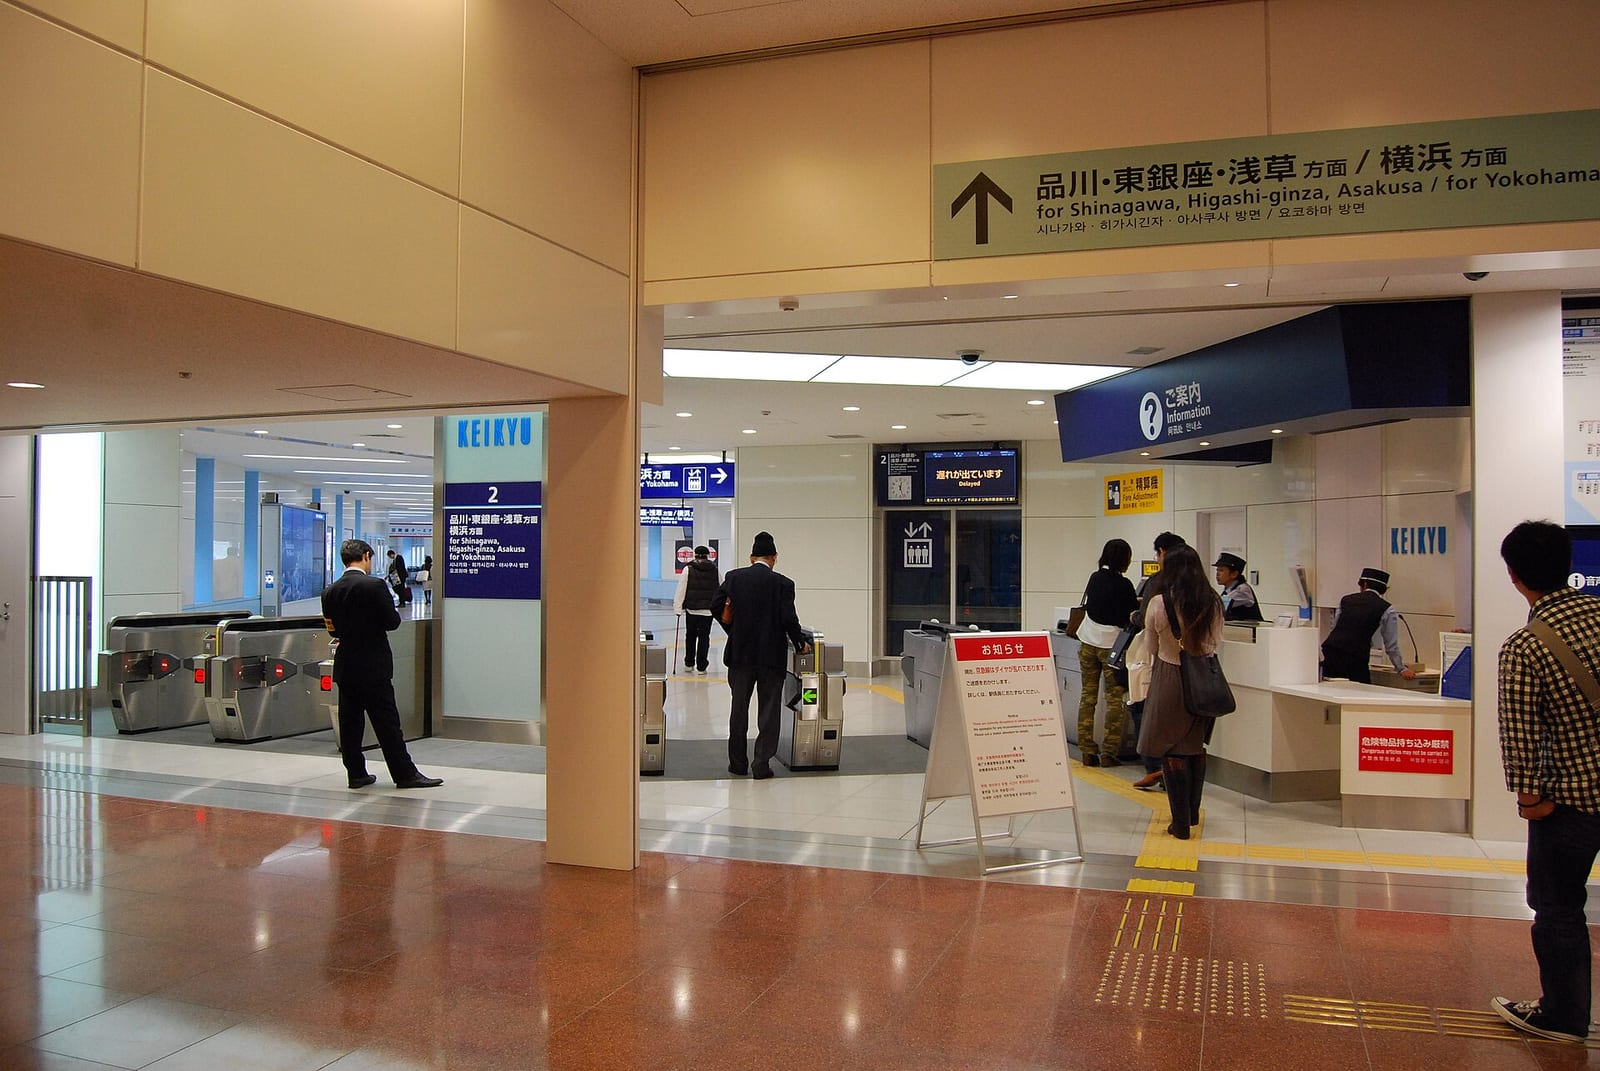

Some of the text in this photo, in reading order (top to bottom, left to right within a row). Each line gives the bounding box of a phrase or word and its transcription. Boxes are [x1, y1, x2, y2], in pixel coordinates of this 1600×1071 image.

[1037, 205, 1064, 219] for
[1071, 198, 1180, 218] Shinagawa,
[1189, 187, 1330, 210] Higashi-ginza,
[1338, 180, 1423, 198] Asakusa
[1447, 174, 1478, 190] for
[1165, 381, 1201, 408] ご案内
[1166, 405, 1211, 425] Information
[458, 417, 531, 448] KEIKYU
[880, 455, 887, 464] 2
[646, 480, 679, 488] Yokohama
[958, 480, 981, 488] Delayed
[488, 486, 499, 503] 2
[449, 537, 500, 547] for Shinagawa,
[1391, 526, 1446, 554] KEIKYU
[449, 545, 526, 556] Higashi-ginza, Asakusa
[449, 553, 496, 561] for Yokohama
[981, 643, 1024, 655] お知らせ
